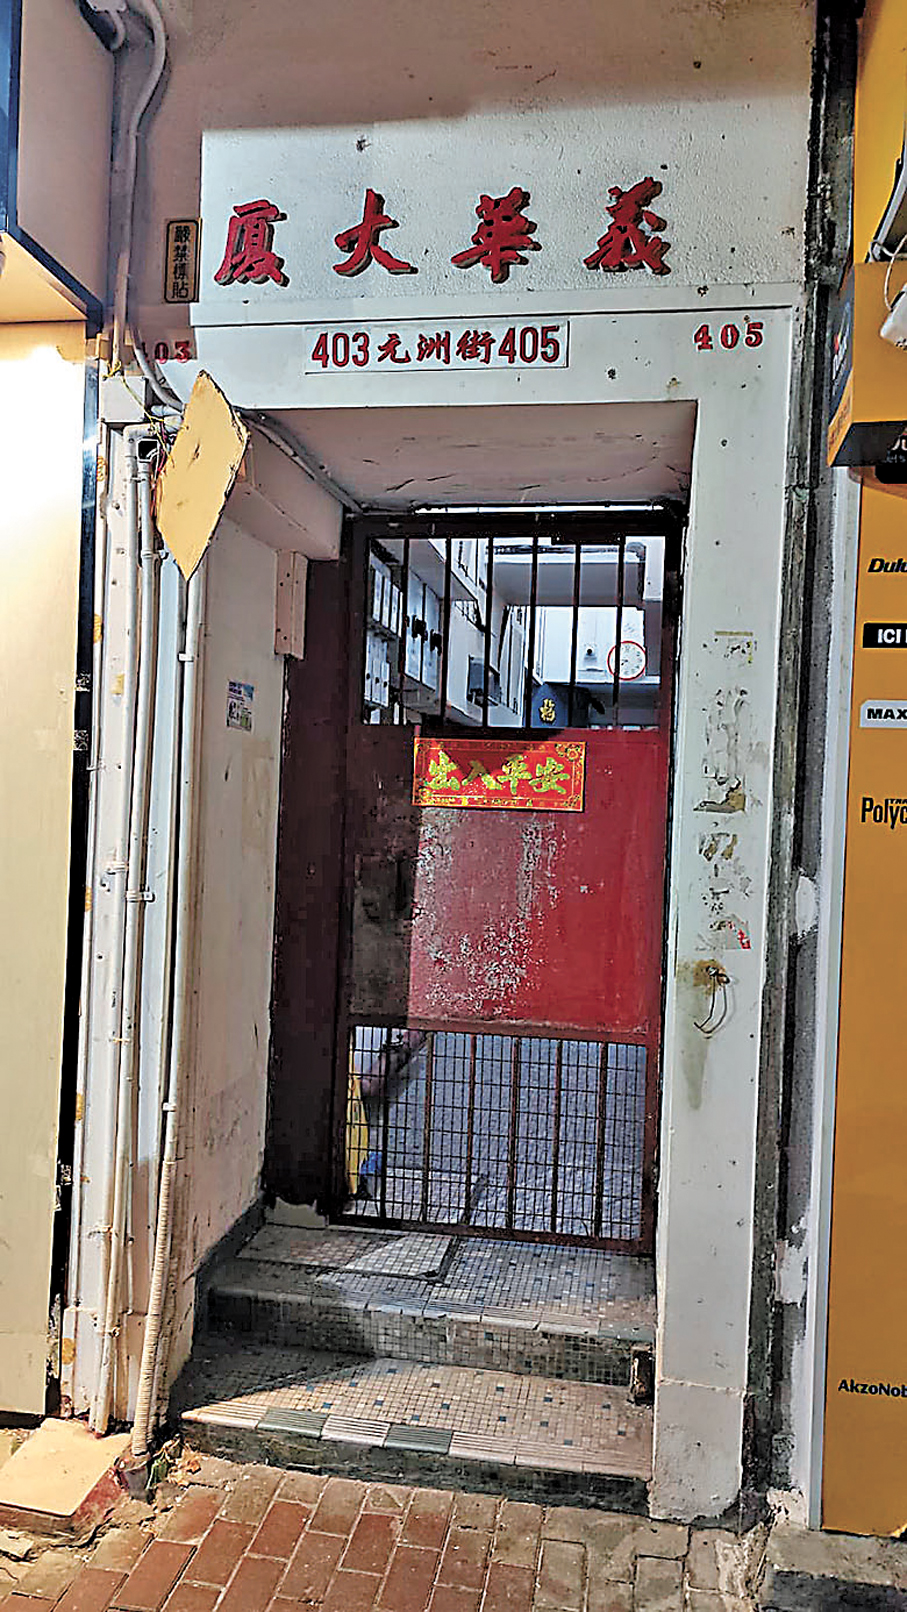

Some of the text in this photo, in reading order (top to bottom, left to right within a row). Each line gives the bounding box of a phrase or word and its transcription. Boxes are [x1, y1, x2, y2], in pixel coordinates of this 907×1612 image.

[694, 321, 764, 350] 405
[877, 628, 902, 644] ICI
[426, 750, 571, 795] 出入平安
